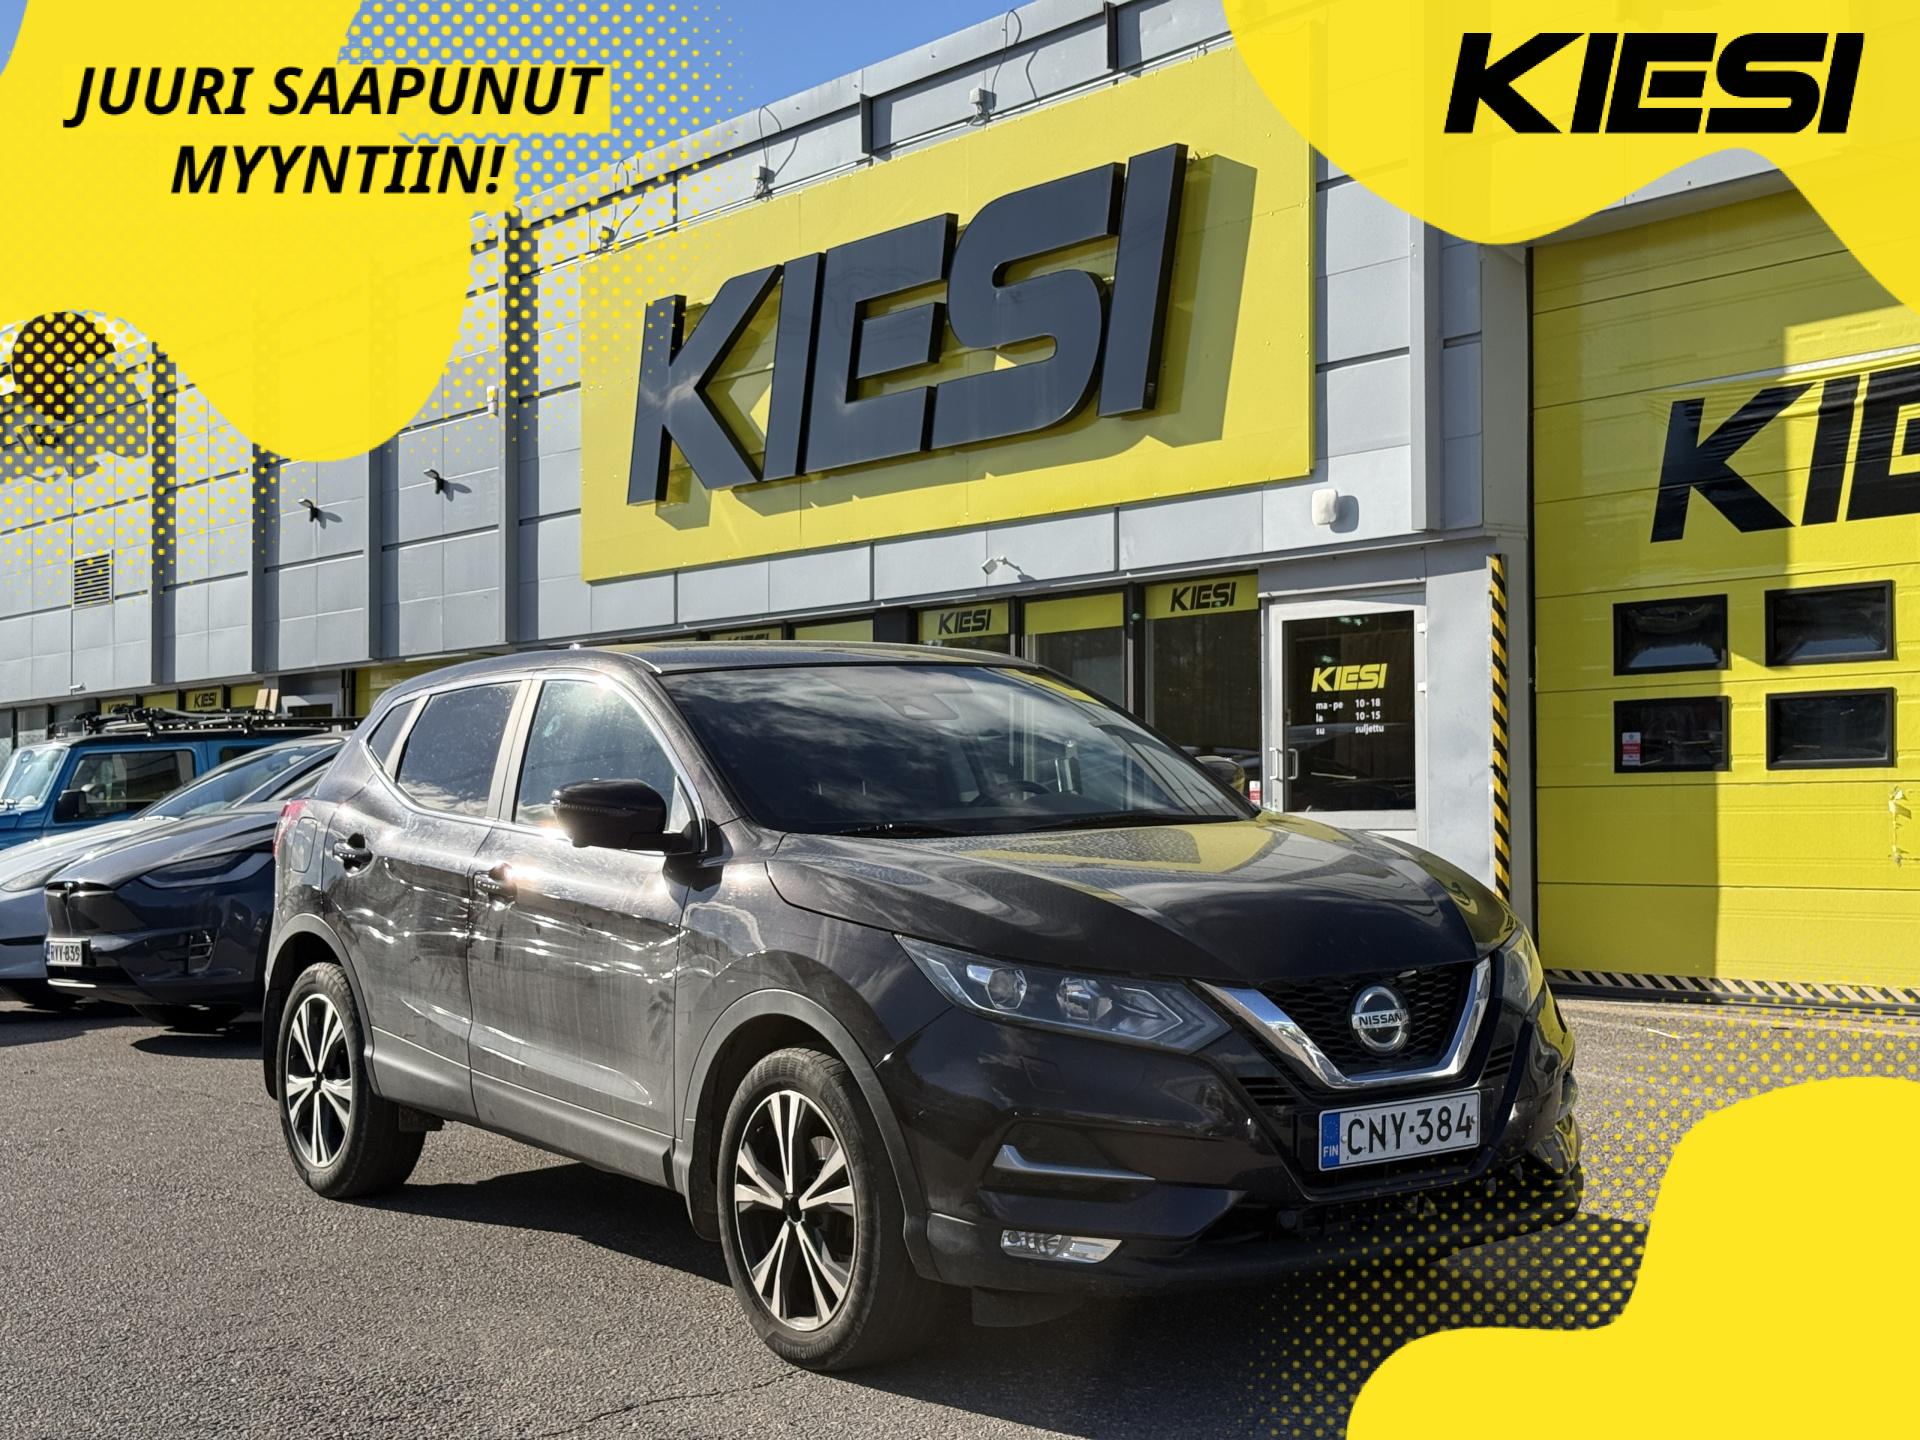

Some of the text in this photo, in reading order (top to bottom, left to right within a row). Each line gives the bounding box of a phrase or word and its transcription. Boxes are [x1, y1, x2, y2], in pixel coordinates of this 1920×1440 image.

[627, 143, 1189, 506] KIESI
[1170, 581, 1237, 613] KIESI
[938, 608, 992, 635] KIESI
[1311, 663, 1388, 693] KIESI
[194, 692, 218, 708] KIESI
[1315, 713, 1324, 723] la
[1315, 723, 1385, 735] su suljettu
[1358, 1012, 1403, 1027] NISSAN
[1347, 1103, 1474, 1156] CNY-384
[1323, 1145, 1339, 1158] FIN
